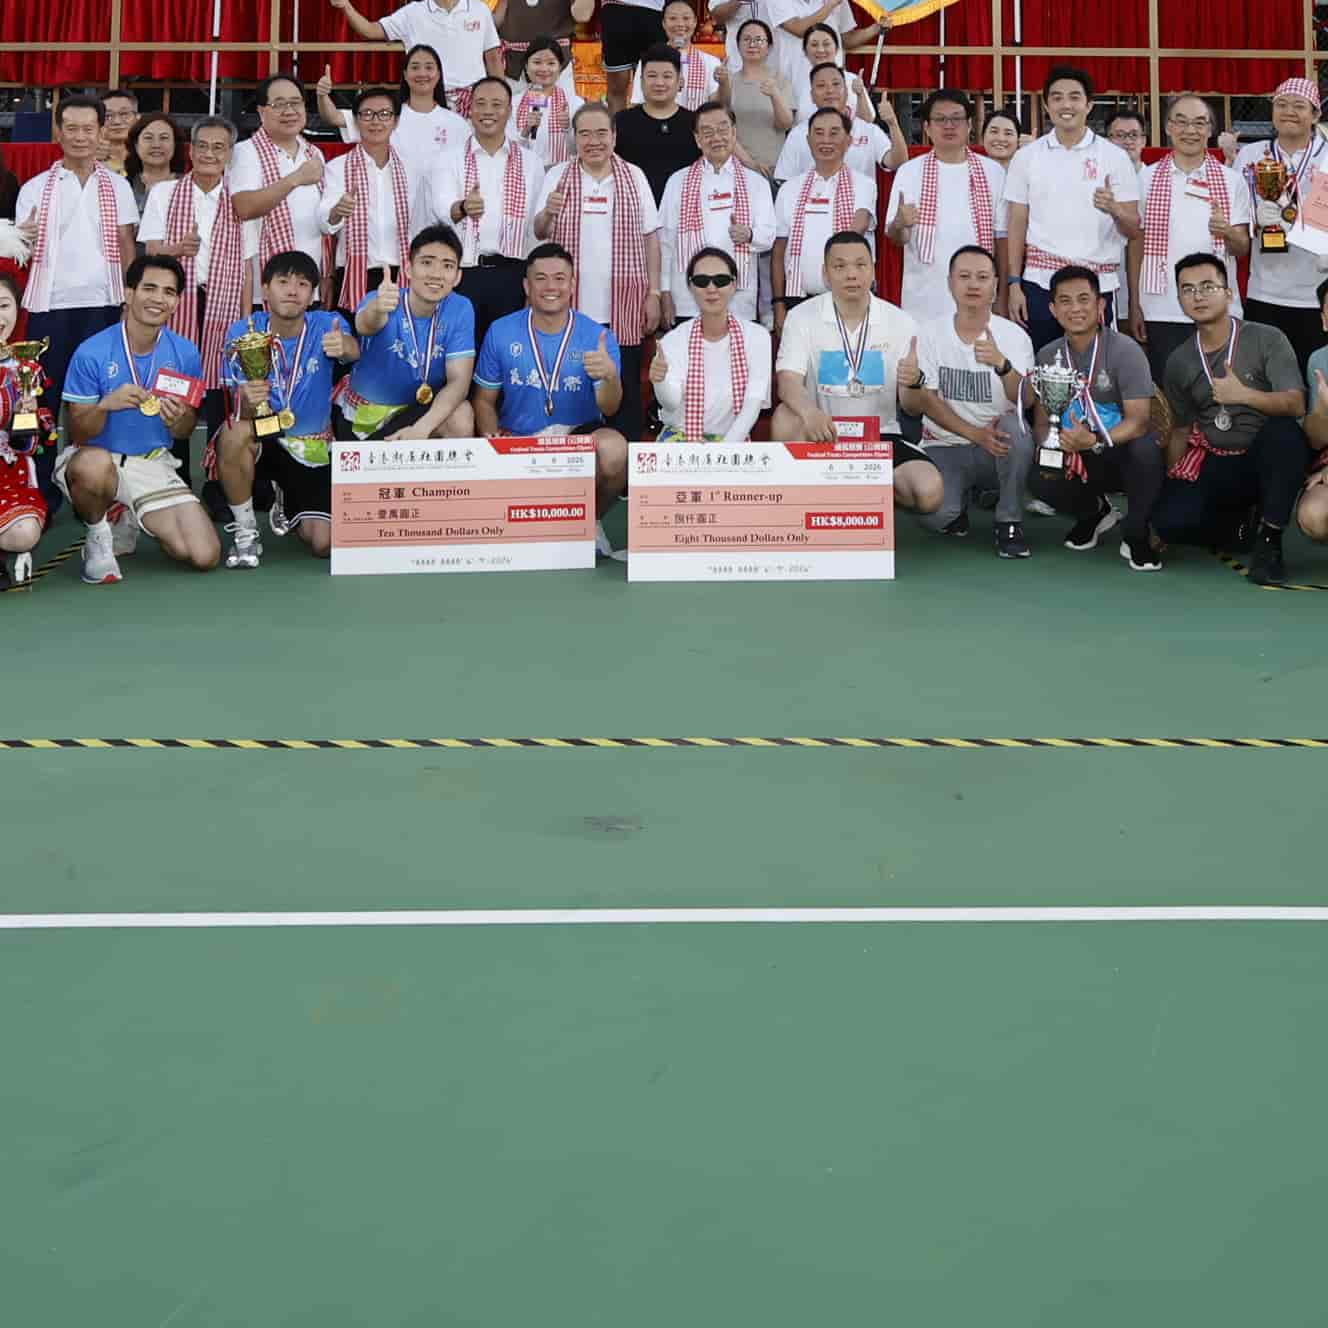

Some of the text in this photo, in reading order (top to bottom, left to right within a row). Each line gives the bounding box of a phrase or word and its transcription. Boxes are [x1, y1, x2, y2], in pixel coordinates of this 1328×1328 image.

[378, 486, 471, 500] 冠軍 Champion
[723, 490, 784, 505] Runner-up
[511, 507, 584, 520] HK$10,000.00
[811, 516, 879, 527] HK$8,000.00
[378, 525, 505, 538] Ten Thousand Dollars Only
[674, 533, 810, 545] Eight Thousand Dollars Only
